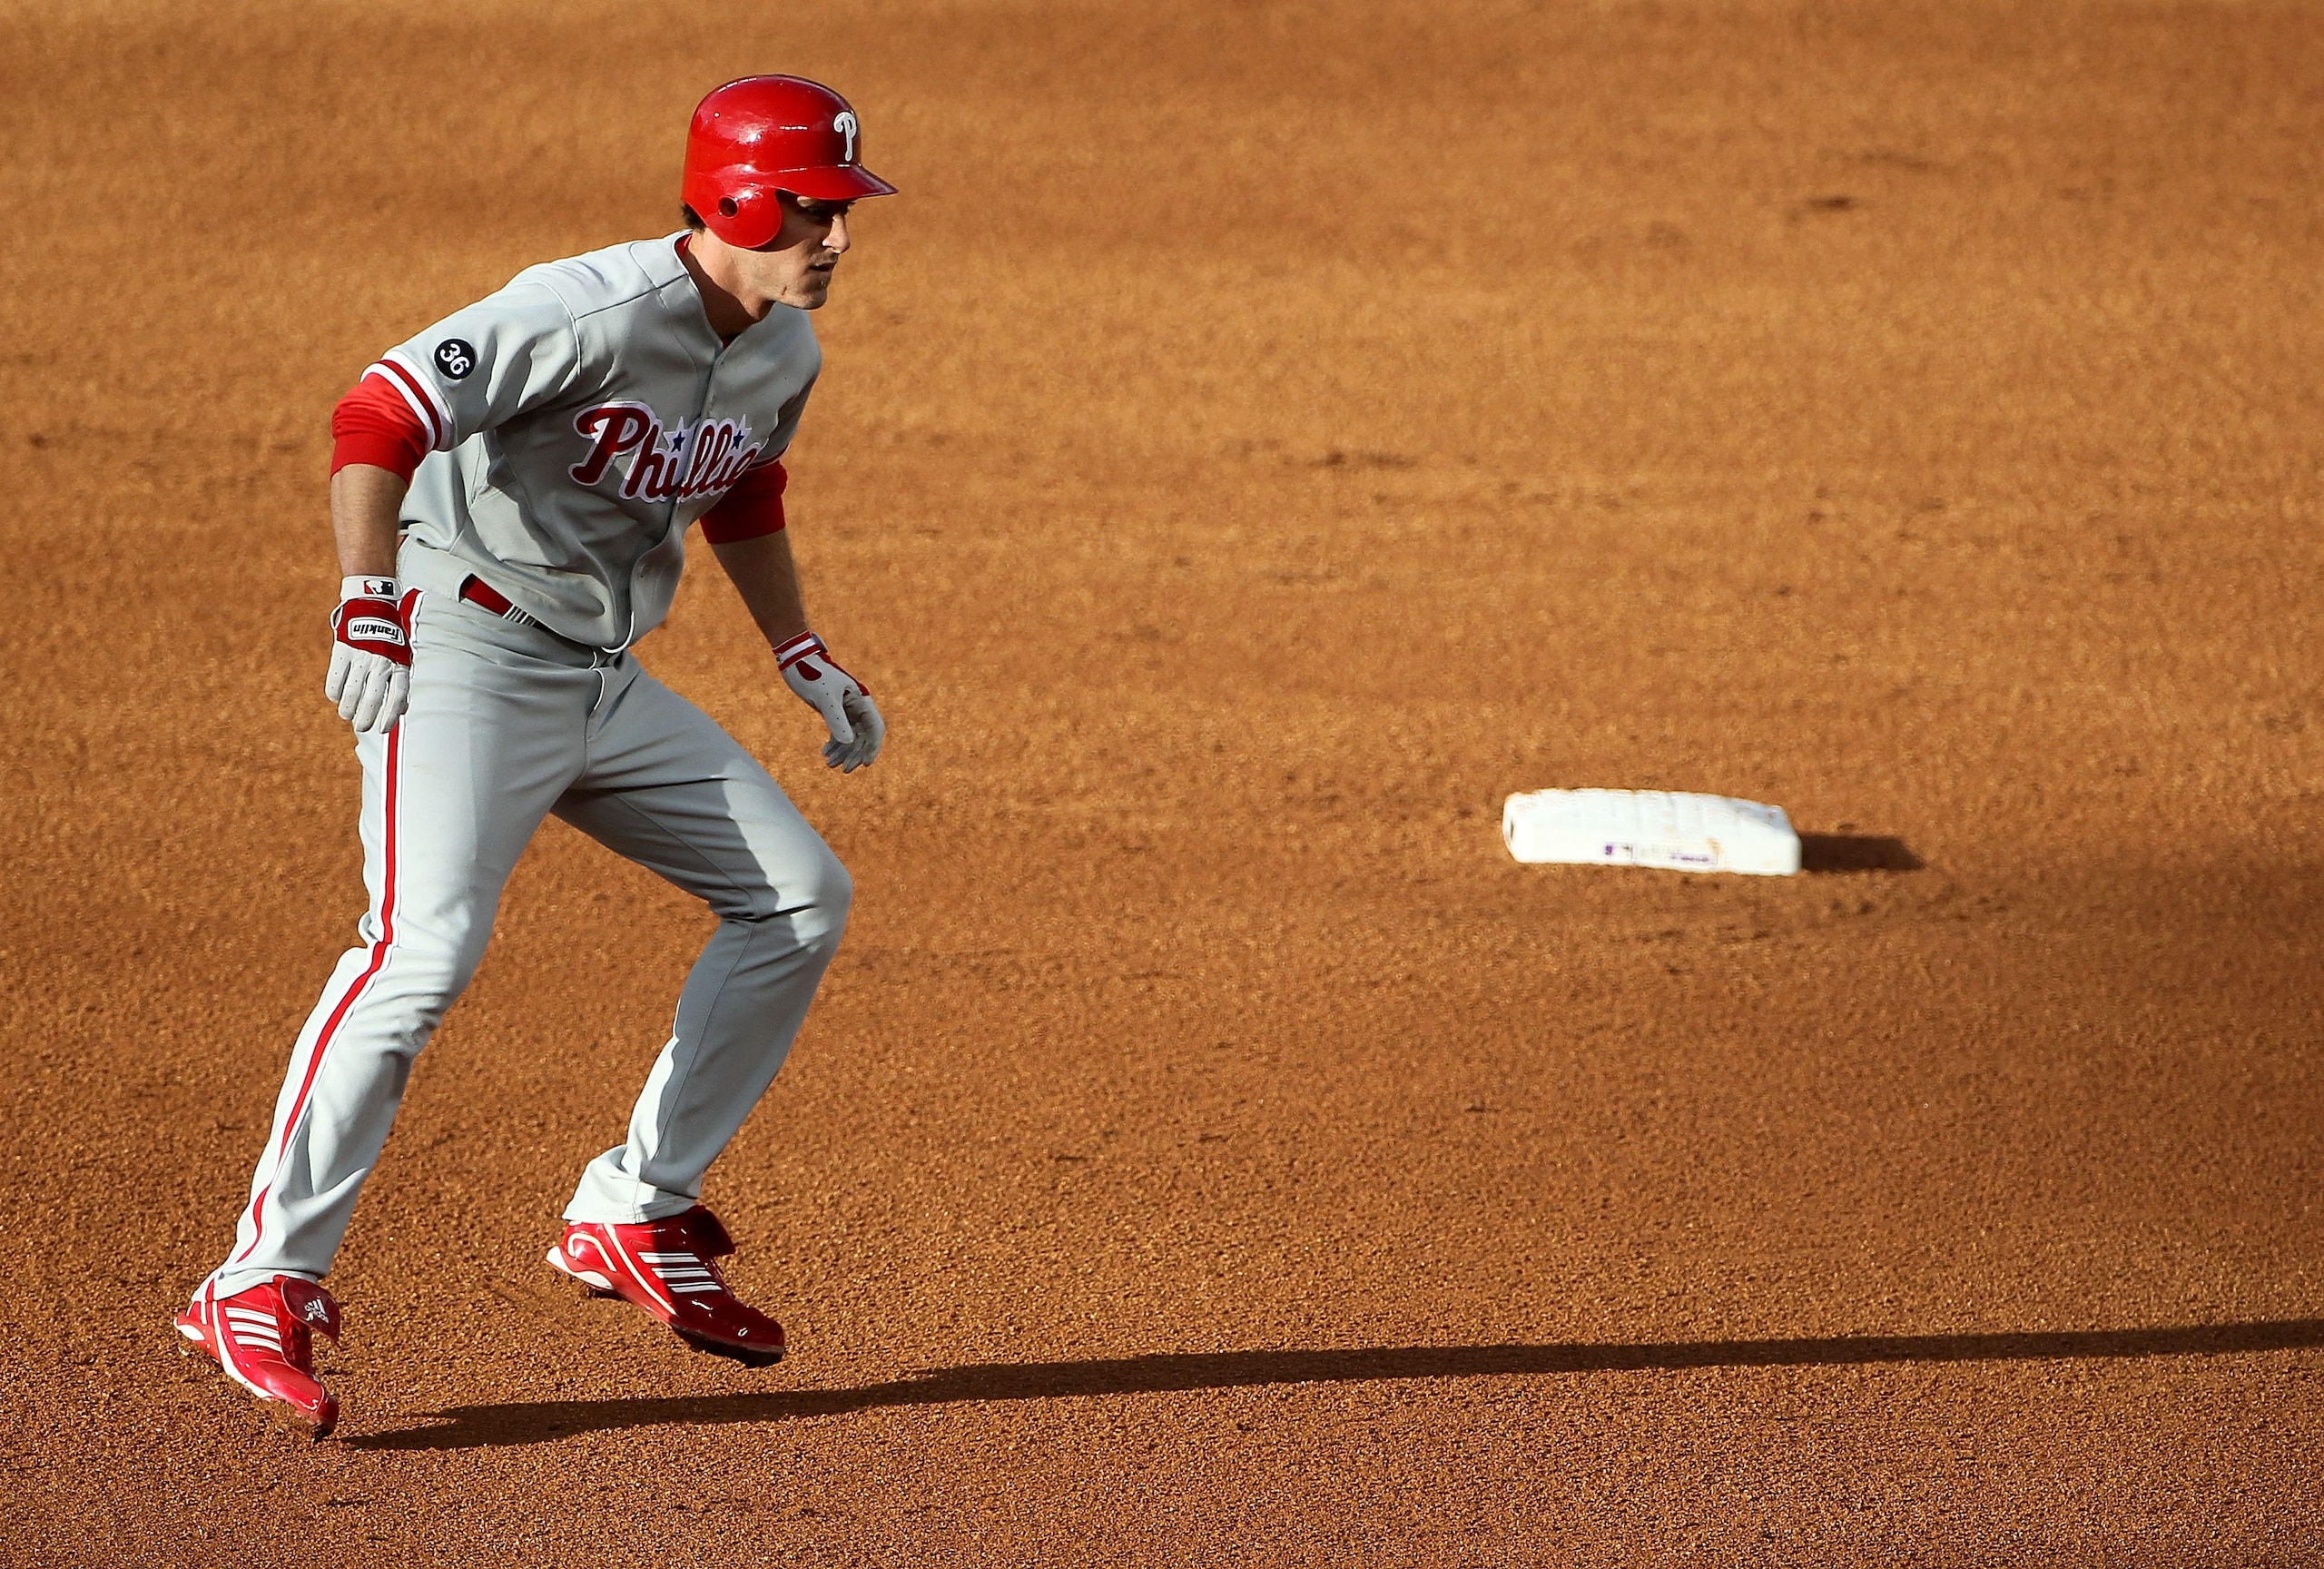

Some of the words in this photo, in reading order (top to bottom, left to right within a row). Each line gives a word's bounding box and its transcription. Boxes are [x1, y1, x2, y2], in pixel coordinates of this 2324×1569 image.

[833, 111, 857, 162] P
[439, 343, 470, 375] 36
[569, 400, 761, 502] Phillie
